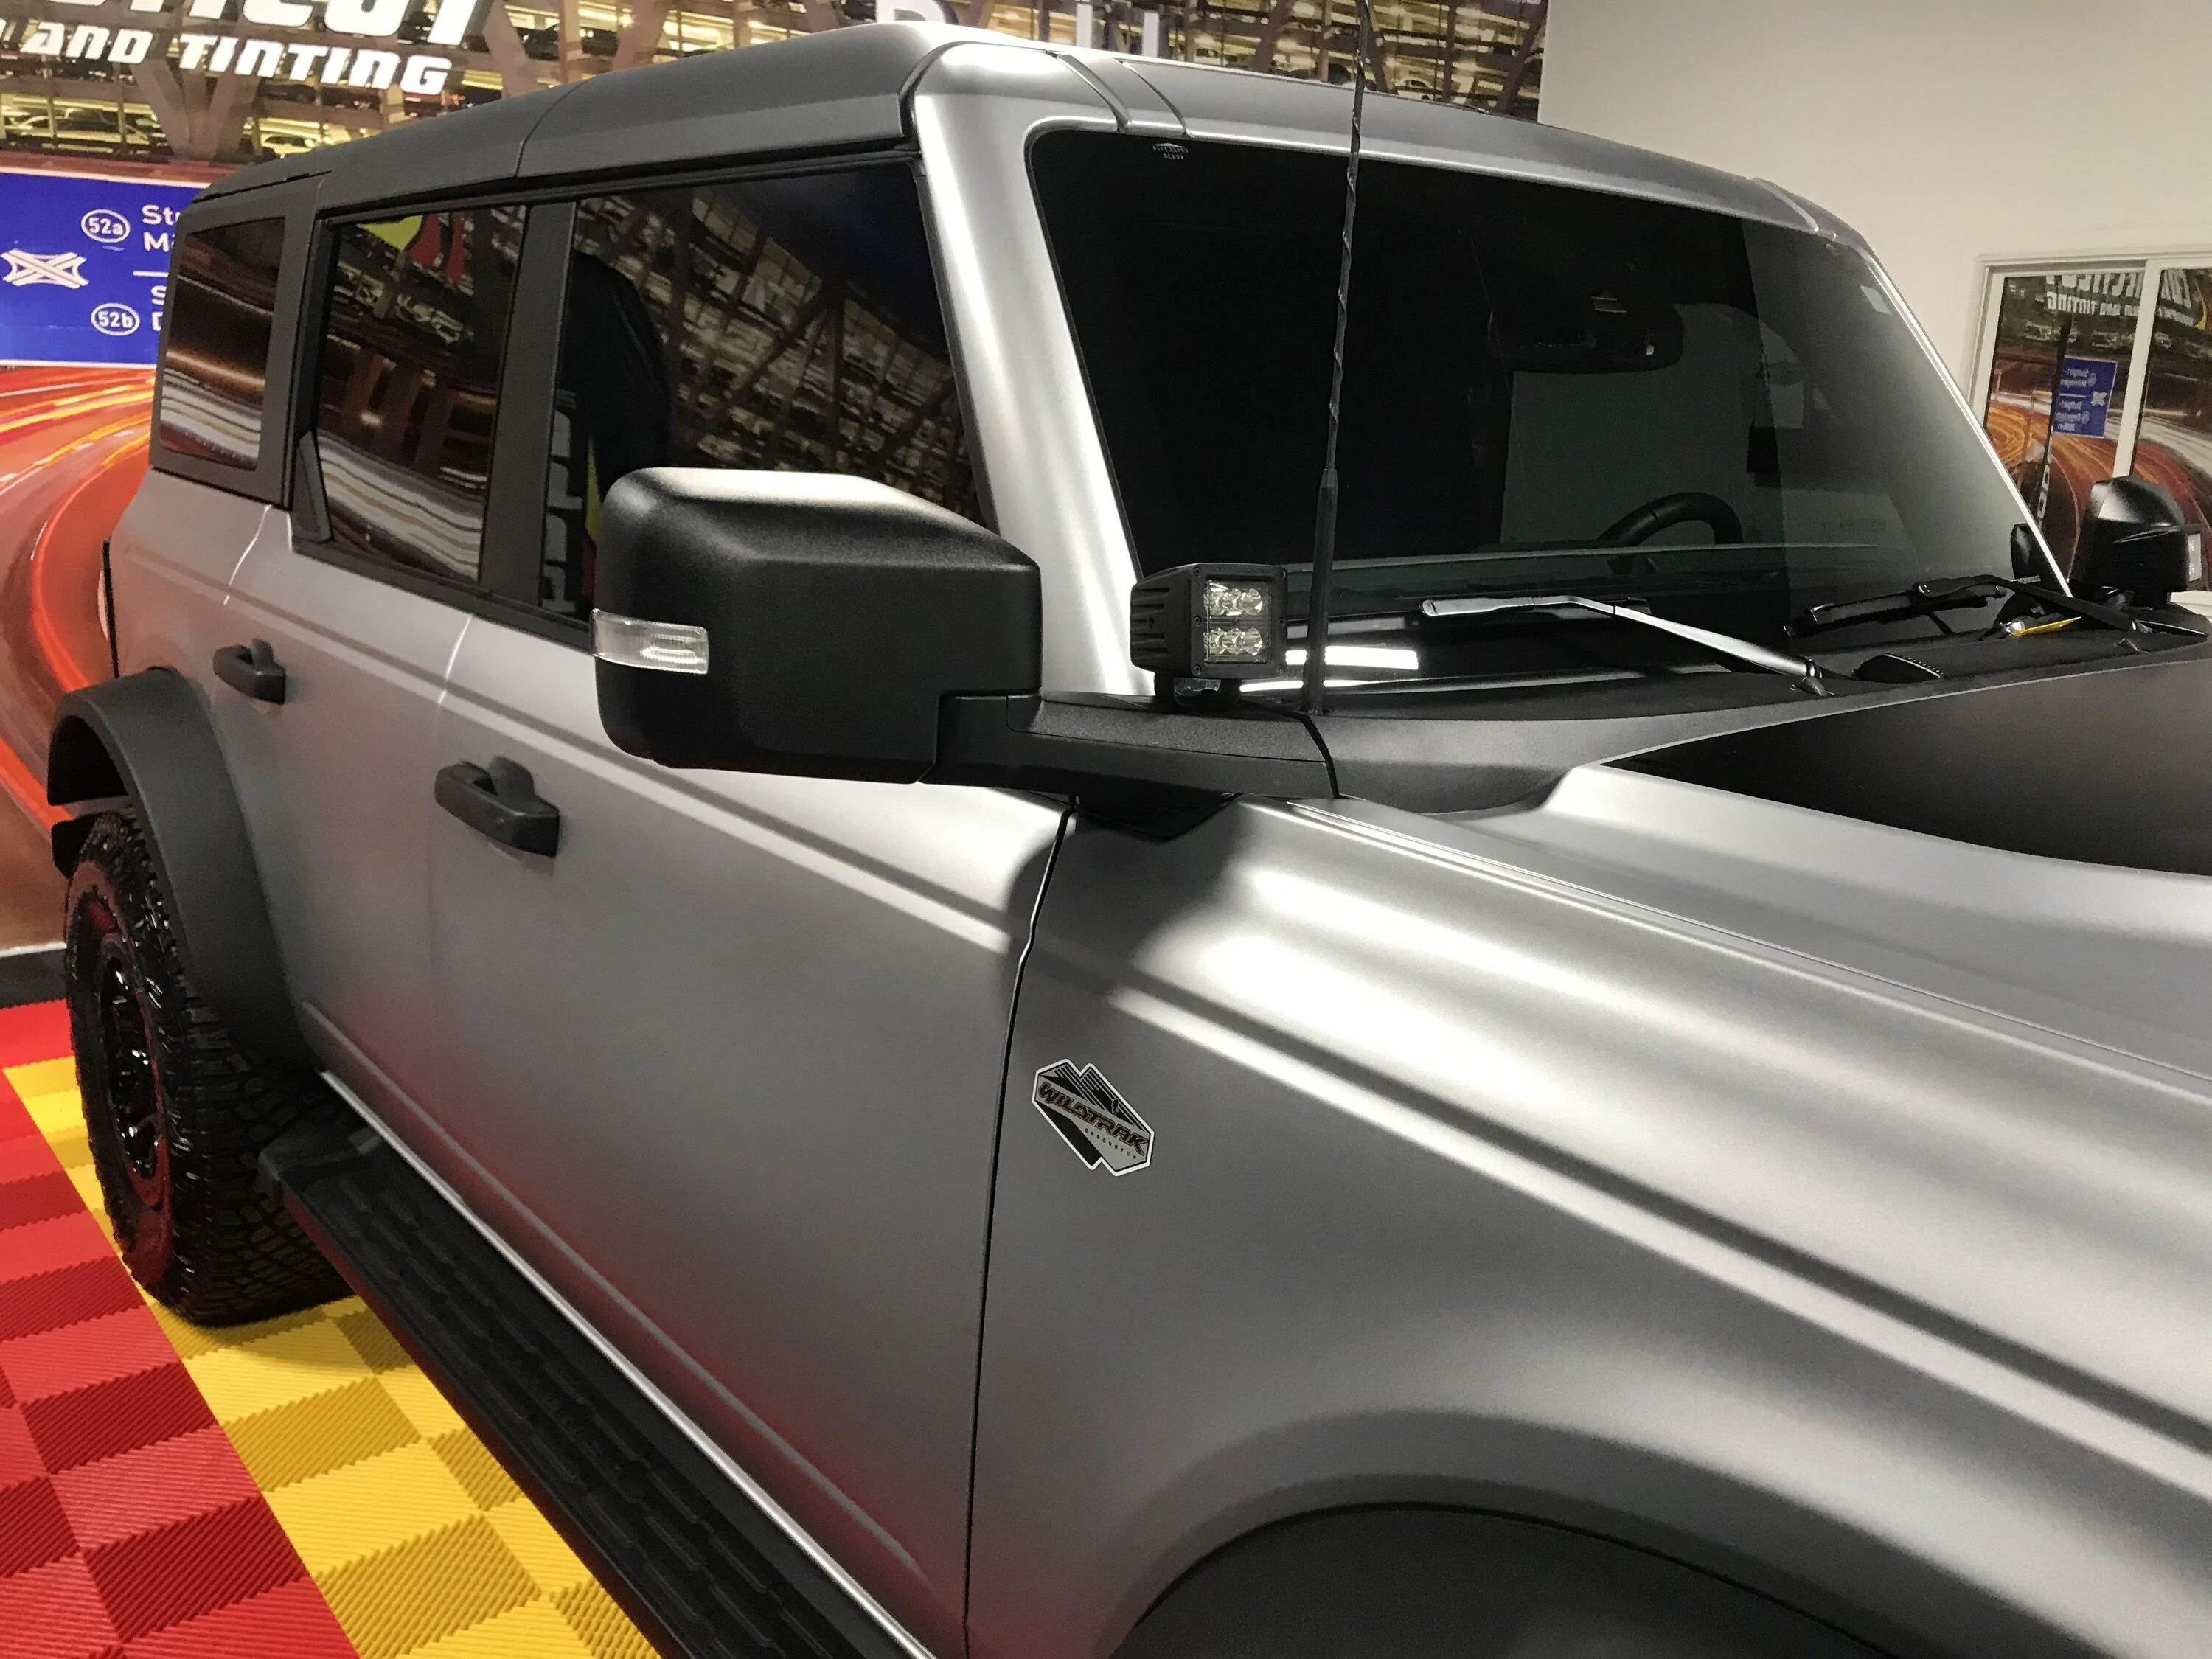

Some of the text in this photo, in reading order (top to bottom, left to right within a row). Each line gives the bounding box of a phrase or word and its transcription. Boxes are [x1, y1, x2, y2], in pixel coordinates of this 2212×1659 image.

[19, 21, 452, 95] AND TINTING
[88, 218, 124, 236] 52a
[97, 310, 134, 329] 52b
[1039, 1082, 1150, 1156] WILDTRAK
